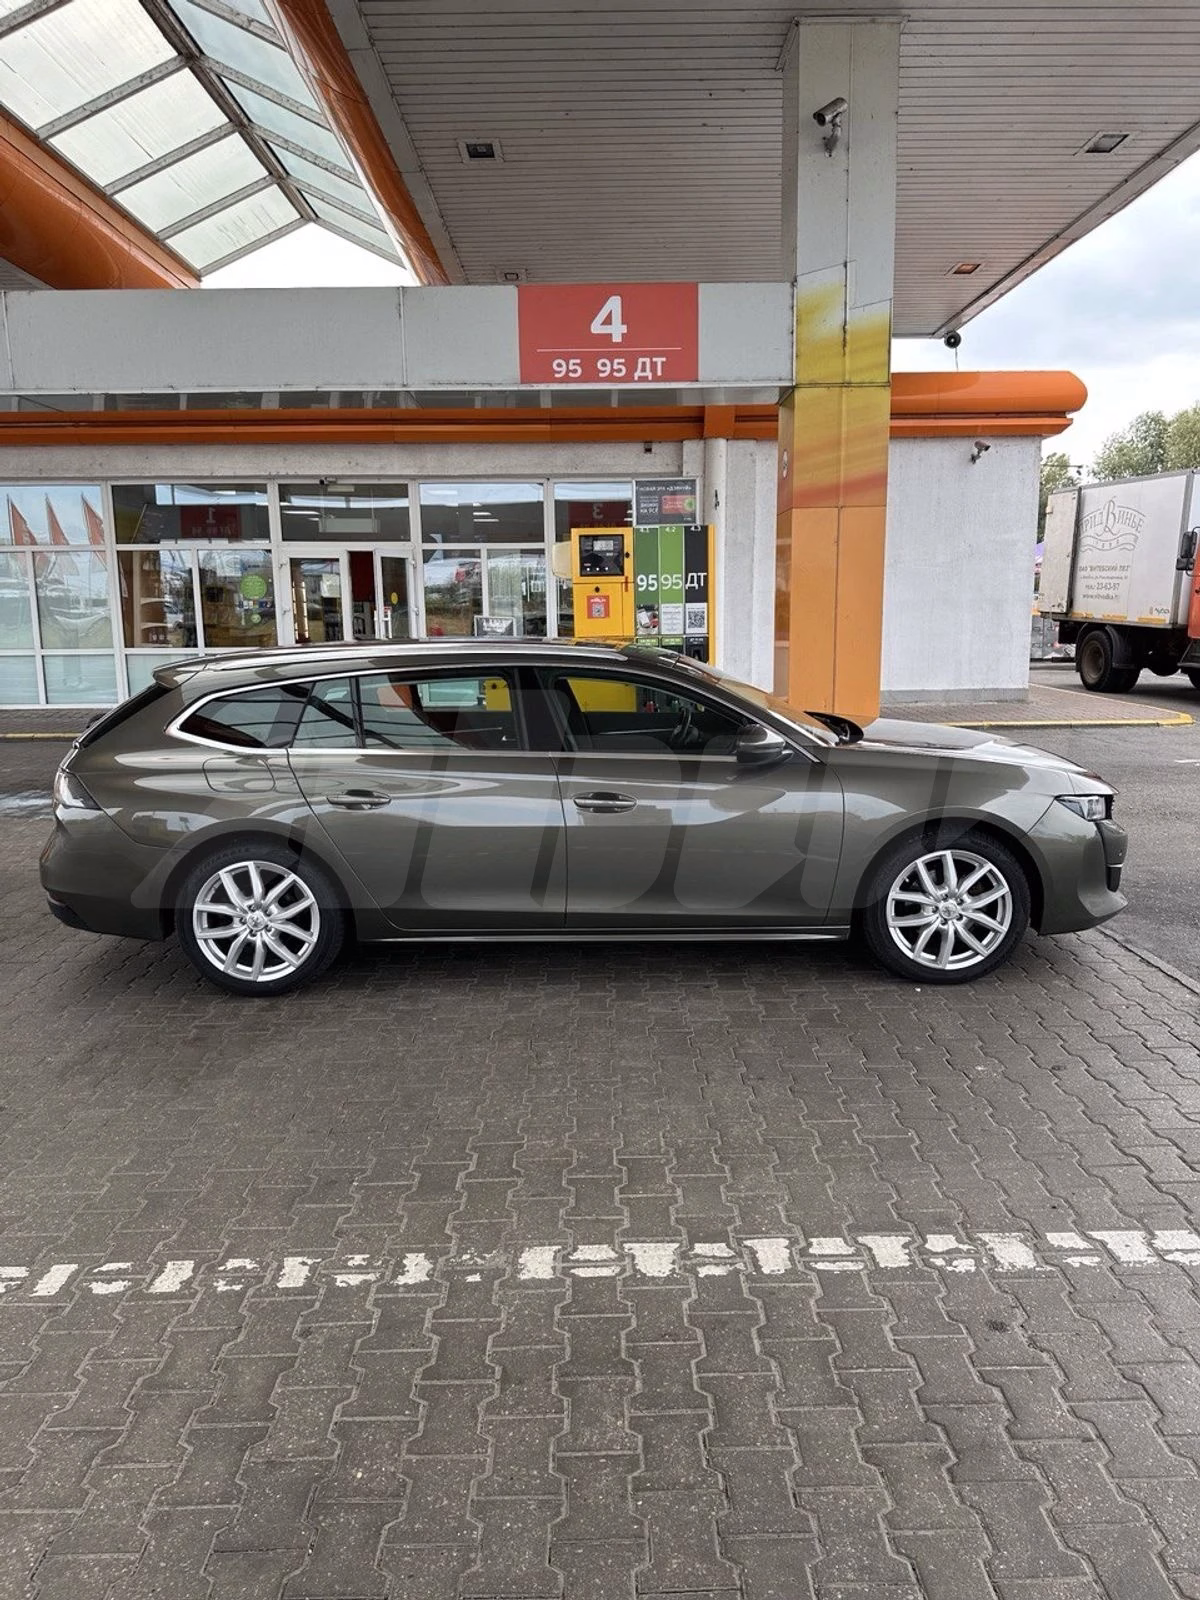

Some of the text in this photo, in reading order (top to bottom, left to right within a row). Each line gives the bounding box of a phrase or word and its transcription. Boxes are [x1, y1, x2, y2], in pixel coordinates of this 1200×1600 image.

[590, 295, 628, 343] 4
[552, 357, 667, 380] 95 95 ДТ
[637, 574, 659, 591] 95
[661, 573, 682, 590] 95
[685, 572, 707, 590] ДТ
